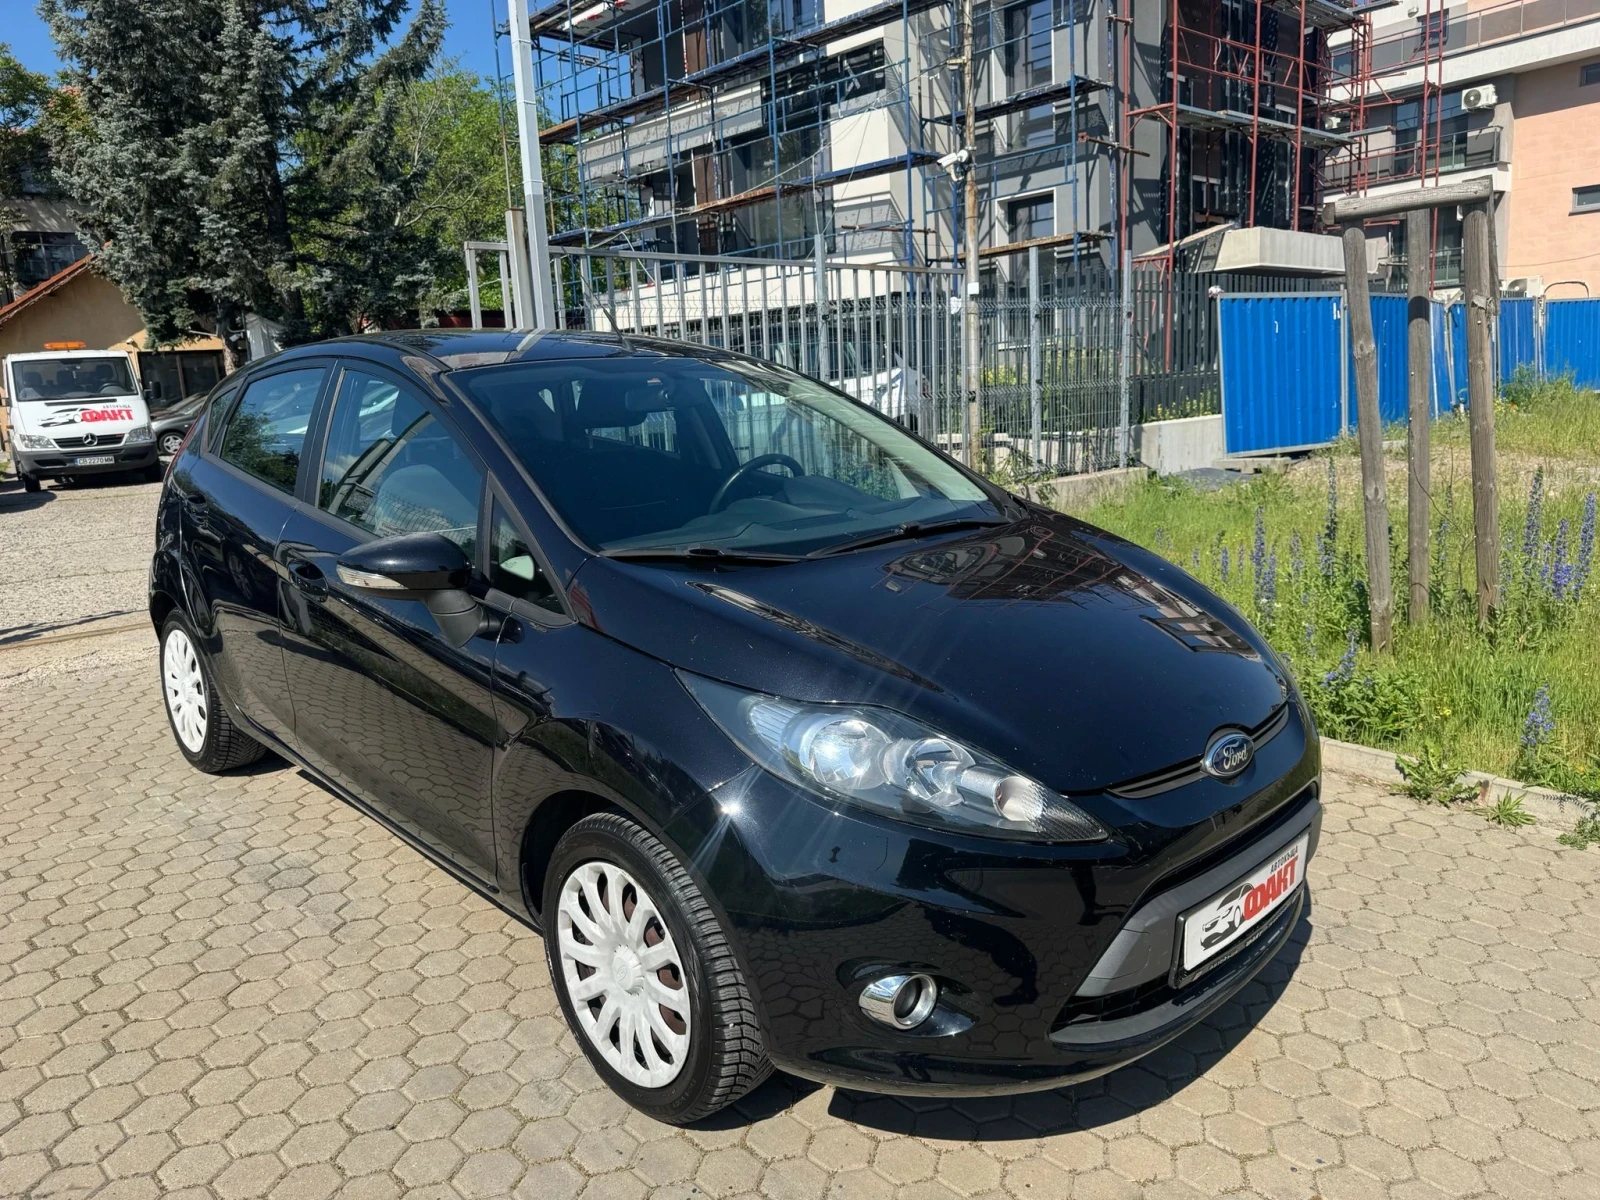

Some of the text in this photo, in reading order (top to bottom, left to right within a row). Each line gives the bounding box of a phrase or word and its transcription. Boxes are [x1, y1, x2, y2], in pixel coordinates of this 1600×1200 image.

[81, 409, 133, 423] ФАКТ
[1223, 741, 1249, 770] Ford
[1243, 855, 1299, 920] ФАКТ
